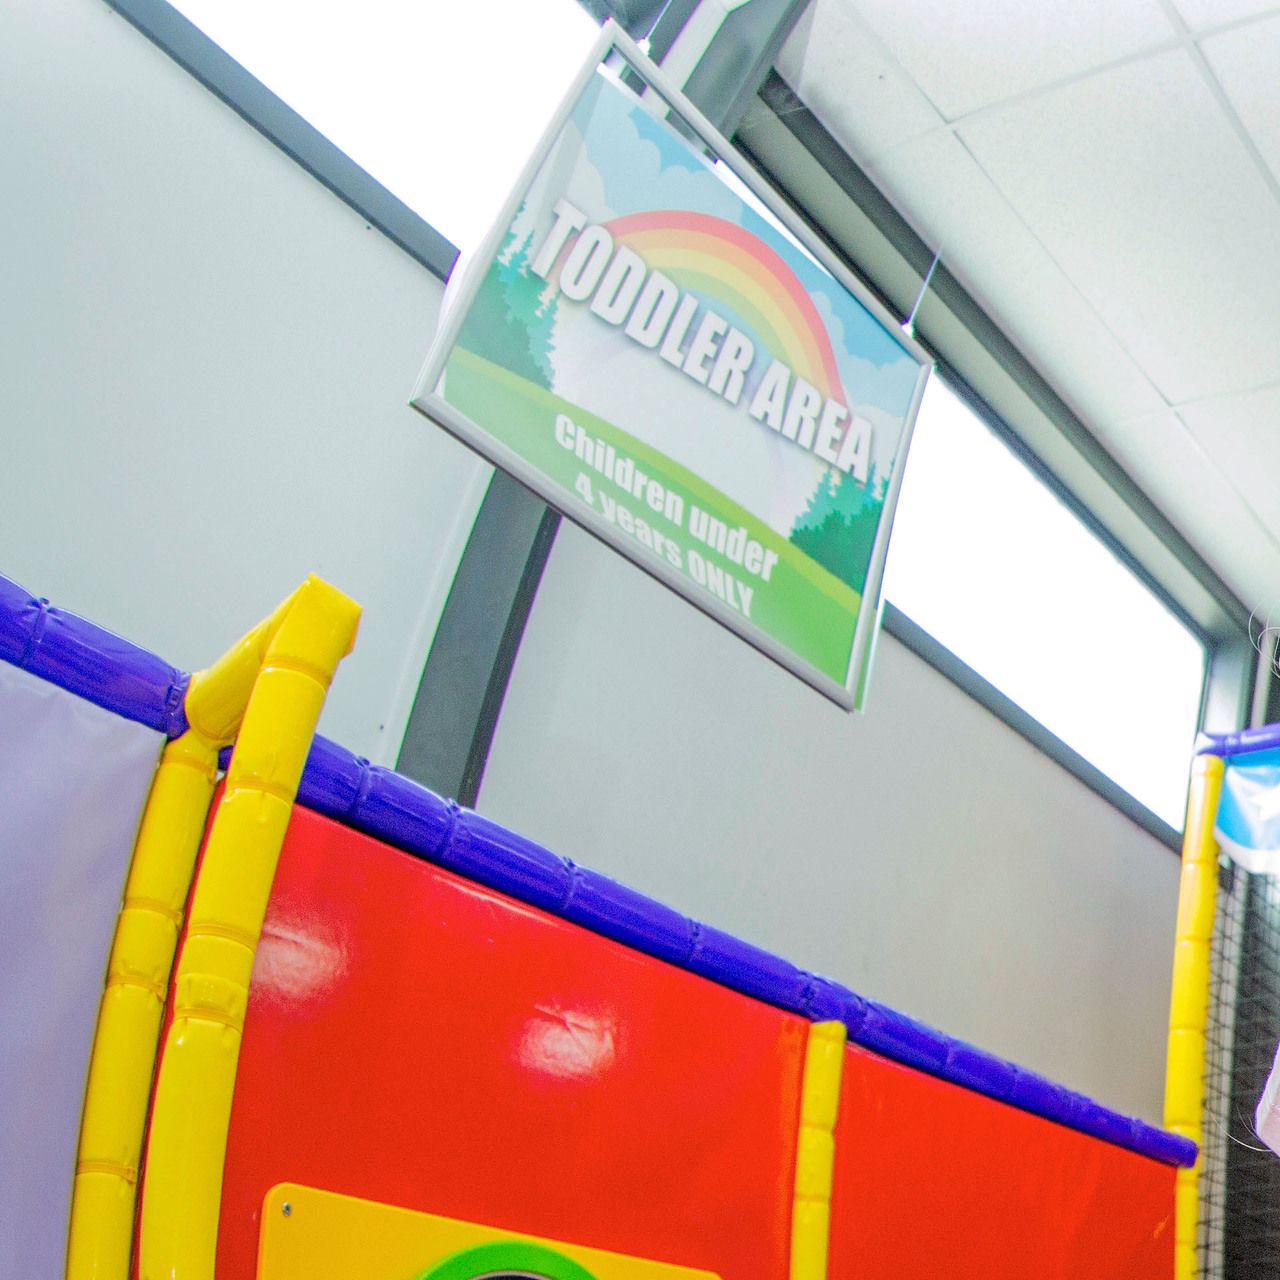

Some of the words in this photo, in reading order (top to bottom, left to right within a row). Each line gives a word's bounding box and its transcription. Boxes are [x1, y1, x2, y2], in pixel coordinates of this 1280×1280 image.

[528, 198, 757, 407] TODDLER
[748, 357, 877, 484] AREA
[553, 412, 685, 527] Children
[688, 497, 779, 583] under
[573, 471, 595, 507] 4
[599, 487, 683, 570] years
[686, 546, 757, 620] ONLY
